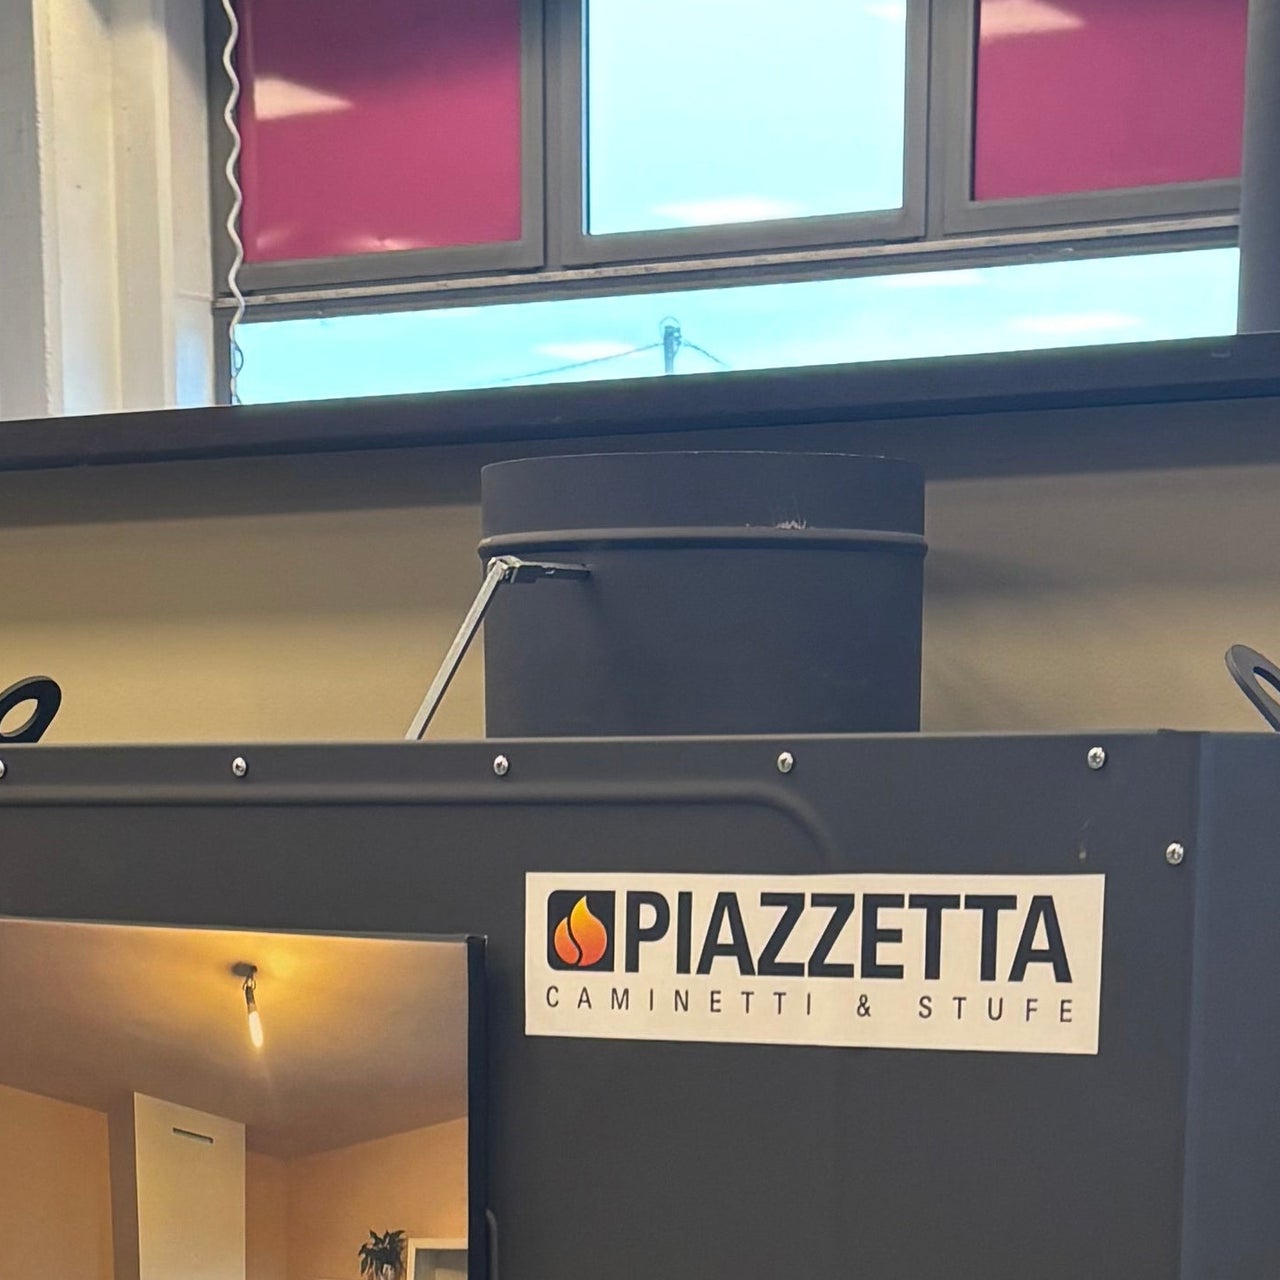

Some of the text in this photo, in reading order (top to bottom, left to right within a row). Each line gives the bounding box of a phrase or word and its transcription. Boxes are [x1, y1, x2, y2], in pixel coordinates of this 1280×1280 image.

[624, 890, 1073, 984] PIAZZETTA
[545, 984, 1074, 1024] CAMINETTI & STUFE
